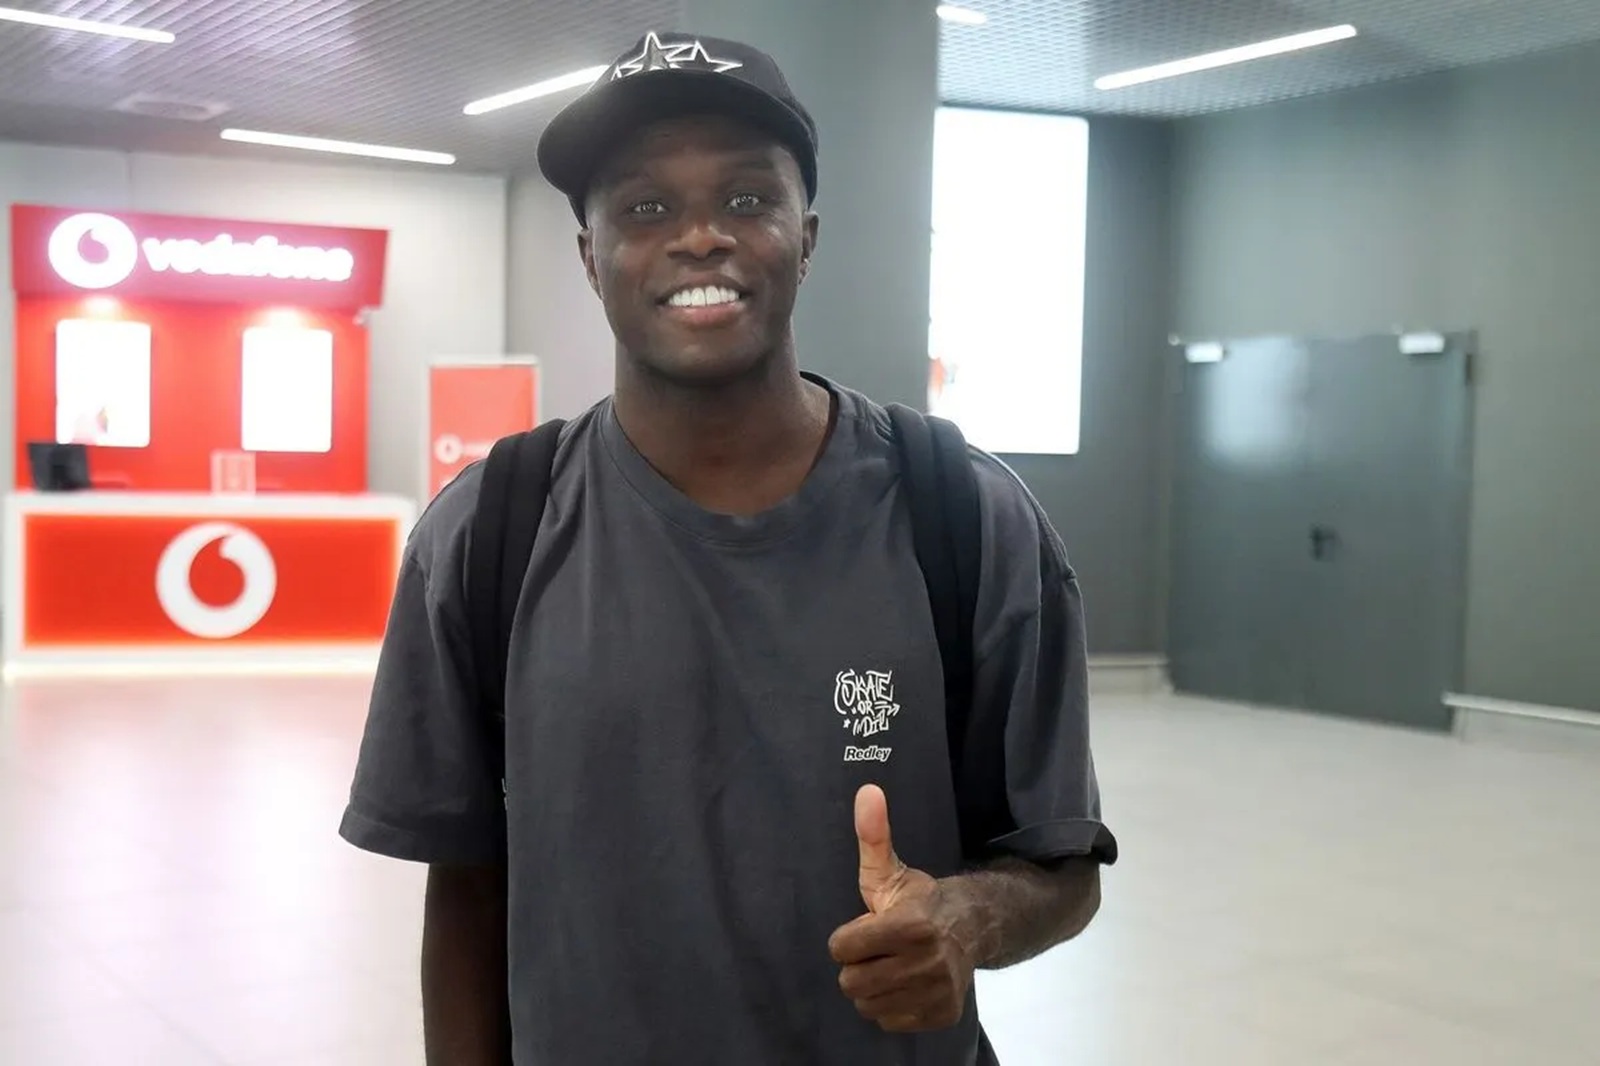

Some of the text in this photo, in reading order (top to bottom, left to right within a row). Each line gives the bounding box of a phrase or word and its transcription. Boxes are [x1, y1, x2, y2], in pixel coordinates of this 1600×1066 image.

[142, 233, 354, 282] vodafone
[840, 668, 893, 706] SKATE
[857, 700, 876, 717] OR
[843, 745, 892, 762] Redley
